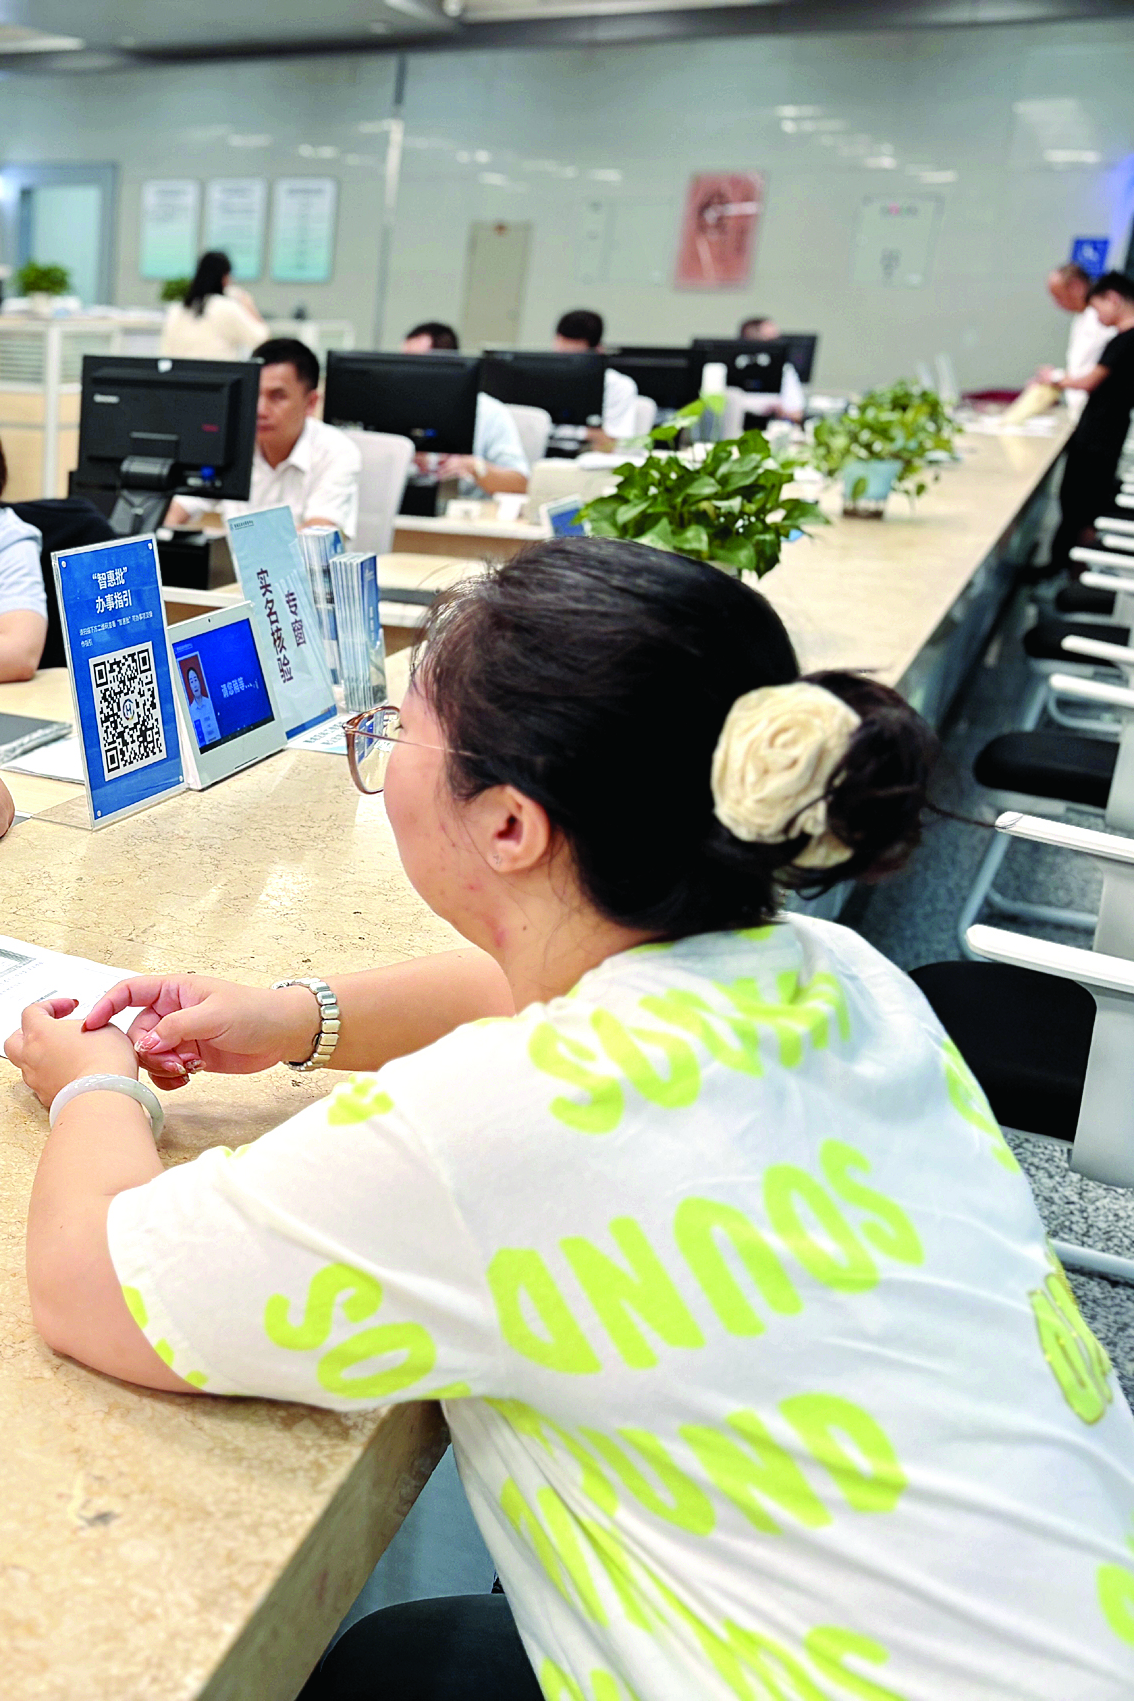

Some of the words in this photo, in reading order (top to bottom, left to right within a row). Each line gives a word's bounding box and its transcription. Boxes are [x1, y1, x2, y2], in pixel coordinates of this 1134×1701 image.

[95, 589, 133, 614] 办事指引
[256, 567, 294, 684] 实名核验
[485, 1138, 925, 1375] SOUND
